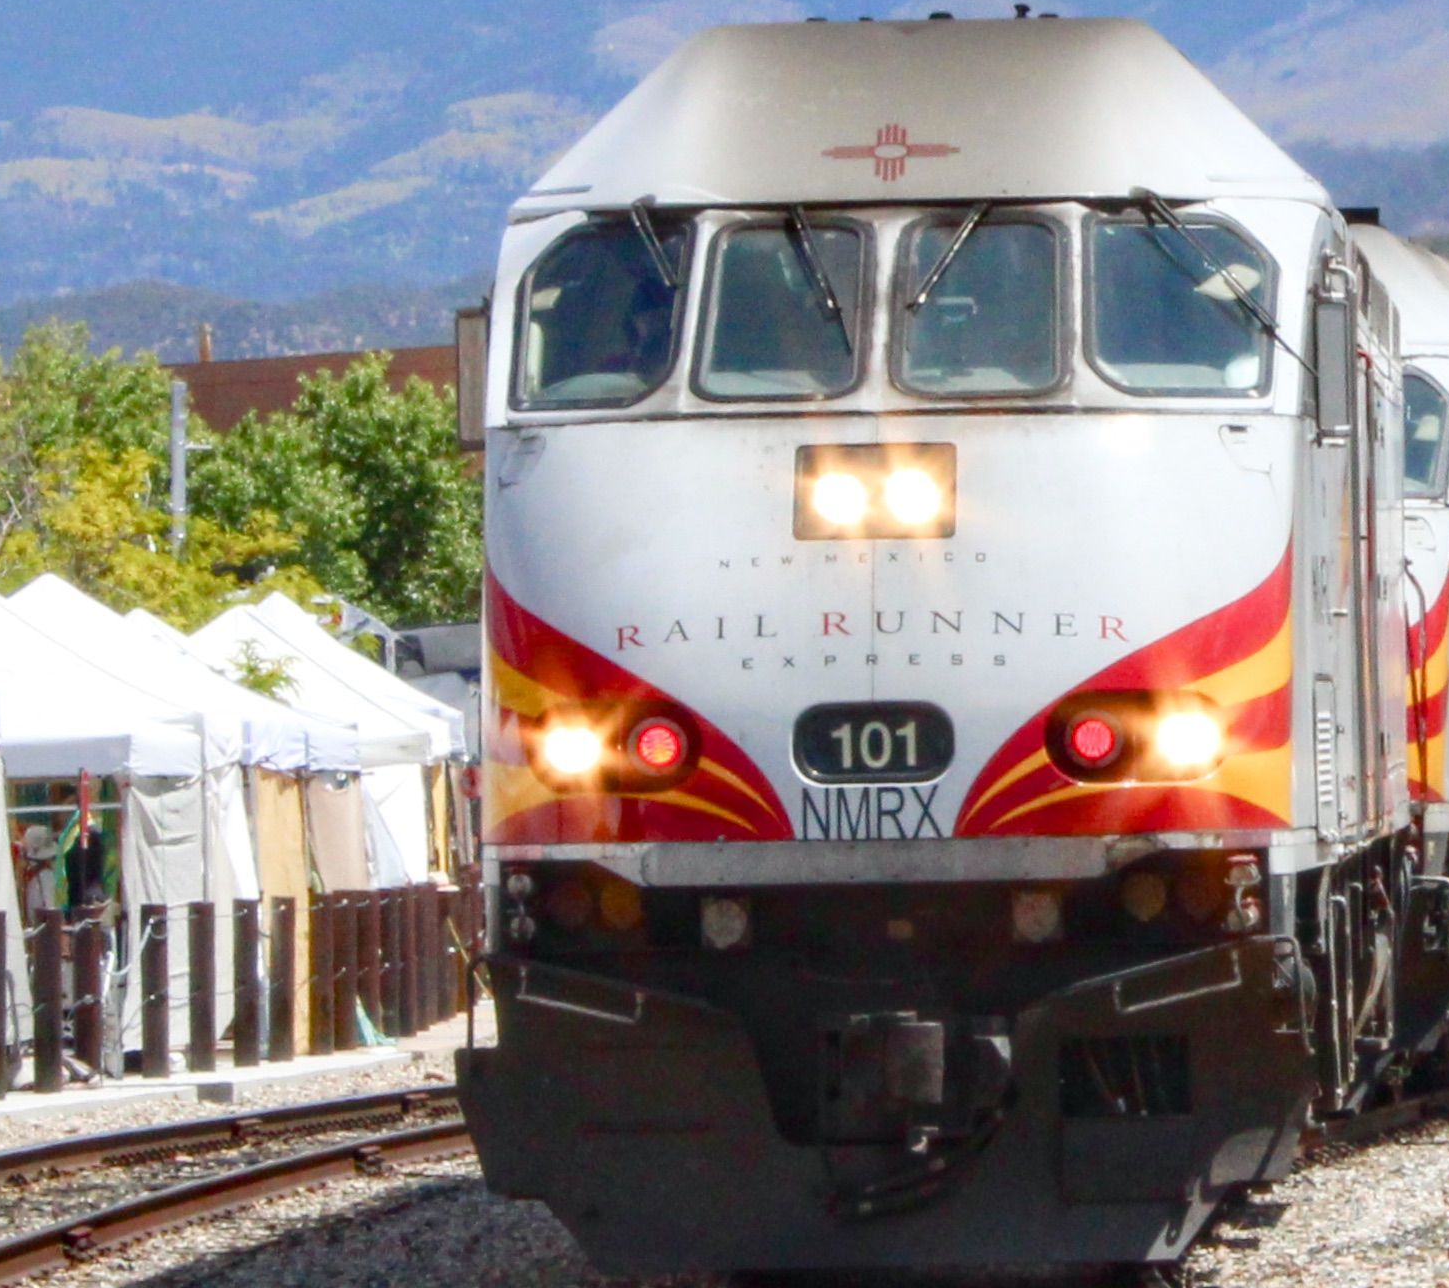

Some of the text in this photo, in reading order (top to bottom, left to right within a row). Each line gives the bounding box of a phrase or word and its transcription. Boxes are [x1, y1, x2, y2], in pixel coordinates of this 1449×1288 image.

[719, 552, 987, 569] NEW MEXICO
[616, 611, 1130, 651] RAIL RUNNER
[742, 653, 1006, 670] EXPRESS
[831, 719, 919, 770] 101
[801, 784, 944, 840] NMRX
